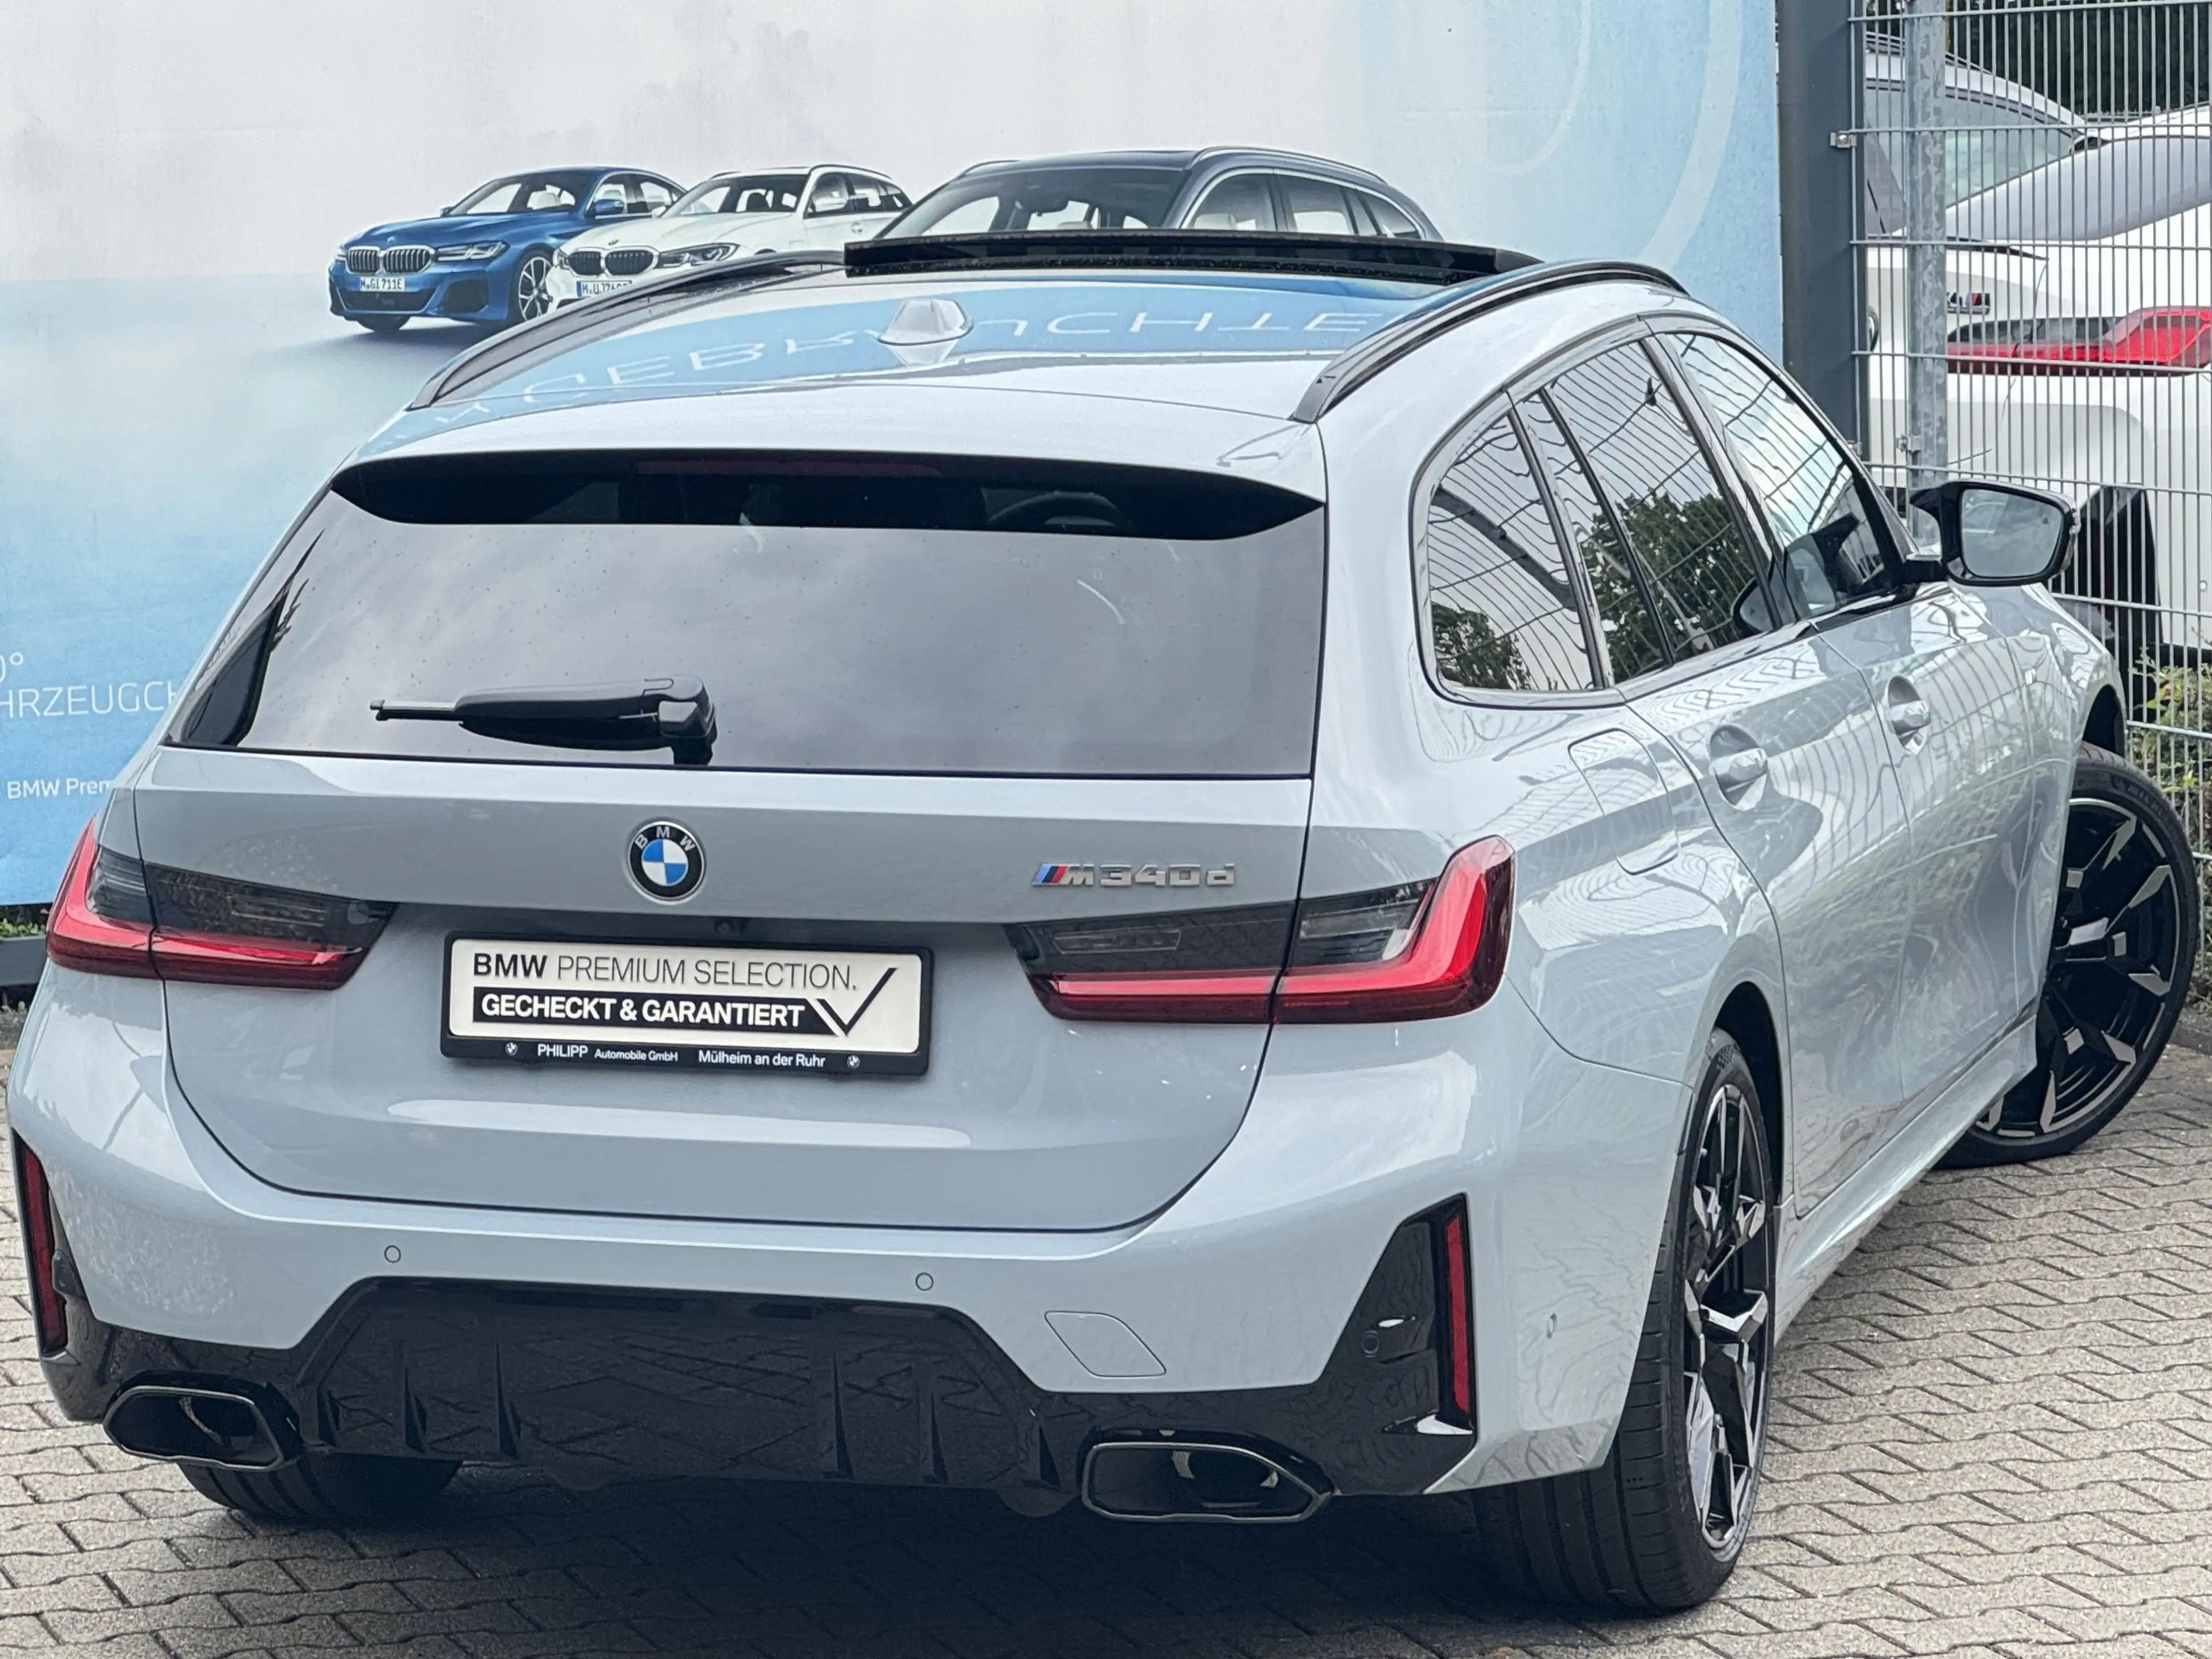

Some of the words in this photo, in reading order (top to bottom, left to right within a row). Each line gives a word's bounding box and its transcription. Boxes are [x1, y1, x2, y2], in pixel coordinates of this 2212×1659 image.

[7, 779, 60, 799] BMW
[635, 826, 696, 851] BMW
[474, 953, 547, 978] BMW
[558, 955, 685, 984] PREMIUM
[694, 960, 858, 991] SELECTION.
[482, 993, 617, 1021] GECHECKT
[619, 999, 638, 1022] &
[642, 1000, 805, 1028] GARANTIERT
[537, 1043, 588, 1058] PHILIPP
[594, 1048, 646, 1060] Automobile
[648, 1051, 679, 1062] GmbH
[698, 1050, 752, 1065] Mülheim
[754, 1055, 770, 1066] an
[772, 1053, 793, 1066] der
[796, 1054, 825, 1067] Ruhr
